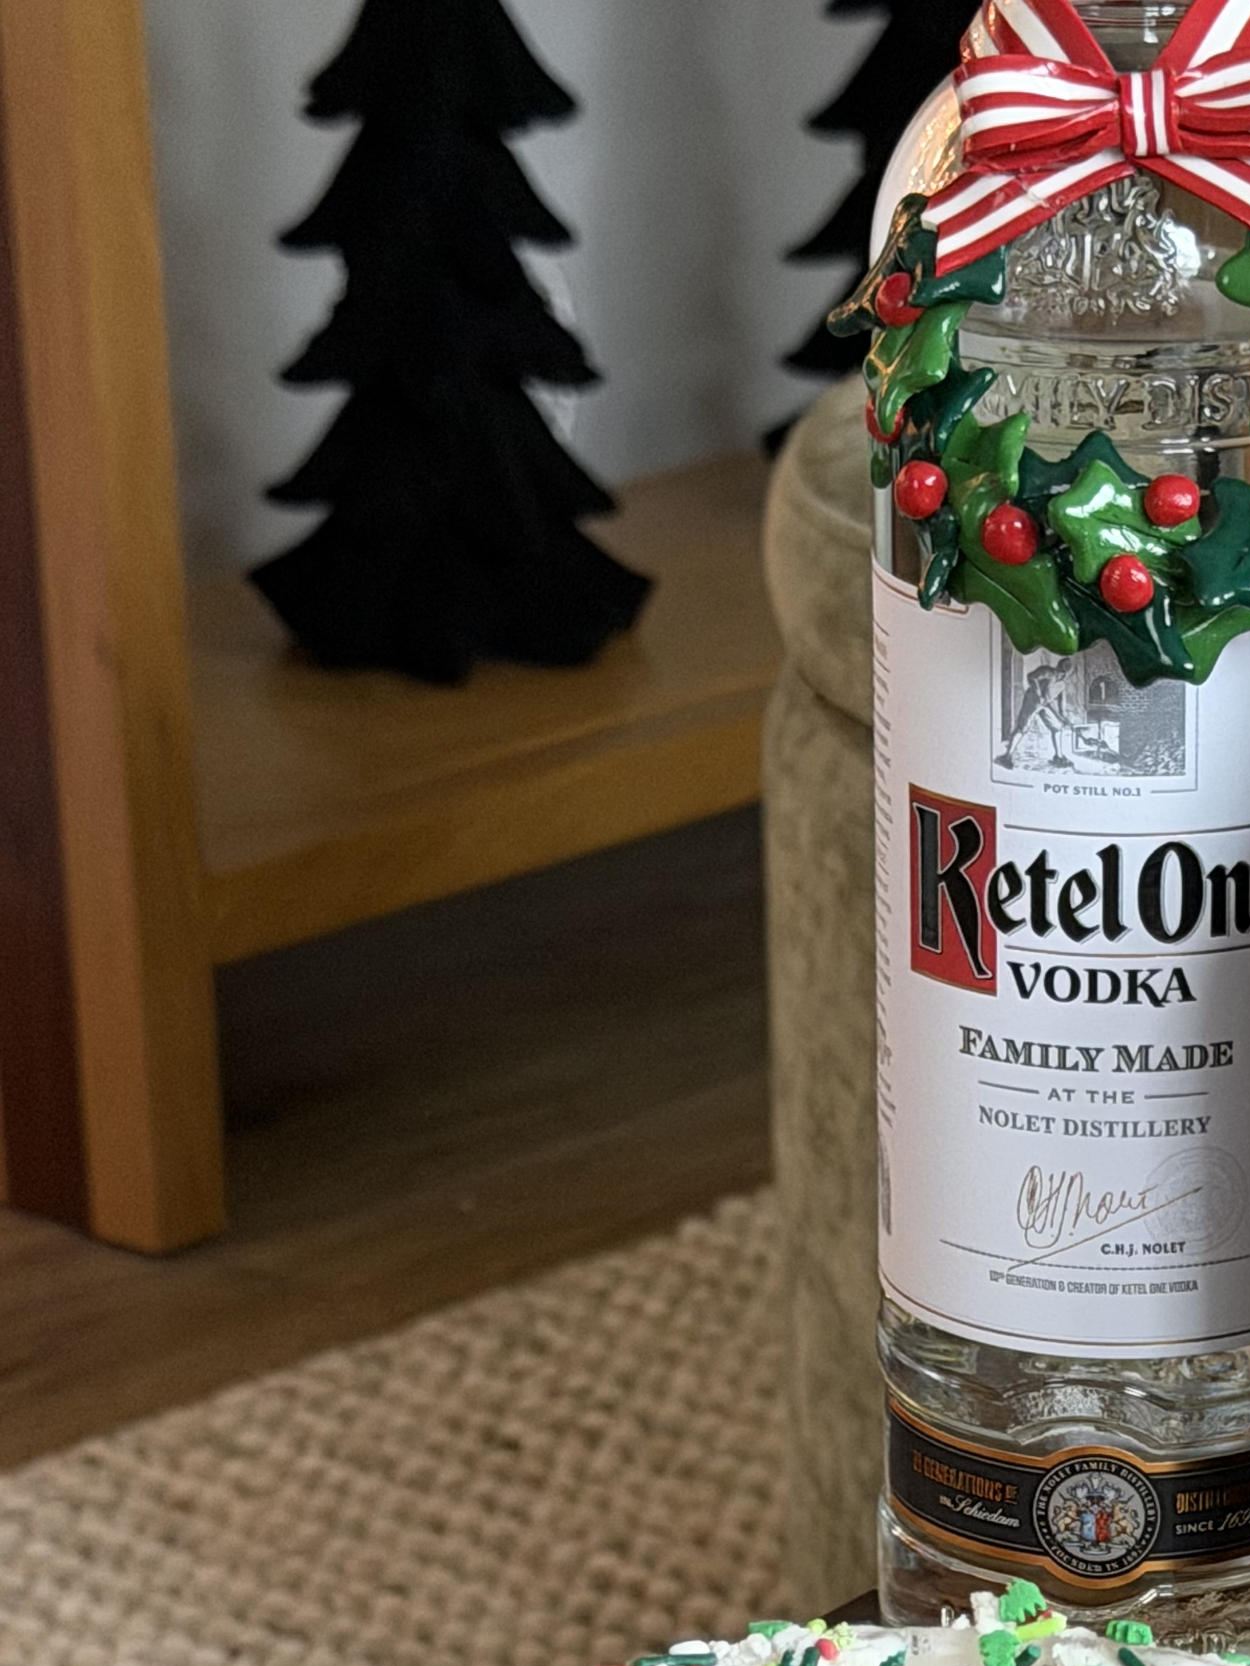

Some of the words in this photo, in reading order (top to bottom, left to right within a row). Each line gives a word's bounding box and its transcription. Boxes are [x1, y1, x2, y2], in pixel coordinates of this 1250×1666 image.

[1043, 783, 1069, 794] POT
[1073, 785, 1108, 796] STILL
[1112, 787, 1141, 797] NO.1
[912, 802, 1131, 979] Ketel
[1006, 961, 1197, 1007] VODKA
[959, 1025, 1105, 1072] FAMILY
[1111, 1040, 1234, 1073] MADE
[1047, 1088, 1076, 1102] AT
[1086, 1089, 1135, 1104] THE
[978, 1105, 1055, 1133] NOLET
[1062, 1115, 1211, 1138] DISTILLERY
[1142, 1241, 1186, 1254] NOLET
[1037, 1493, 1048, 1515] THE
[1075, 1461, 1118, 1473] FAMILY
[1120, 1468, 1156, 1522] DISTILLERY
[952, 1495, 1020, 1527] Schiedam
[1175, 1520, 1214, 1535] SINCE
